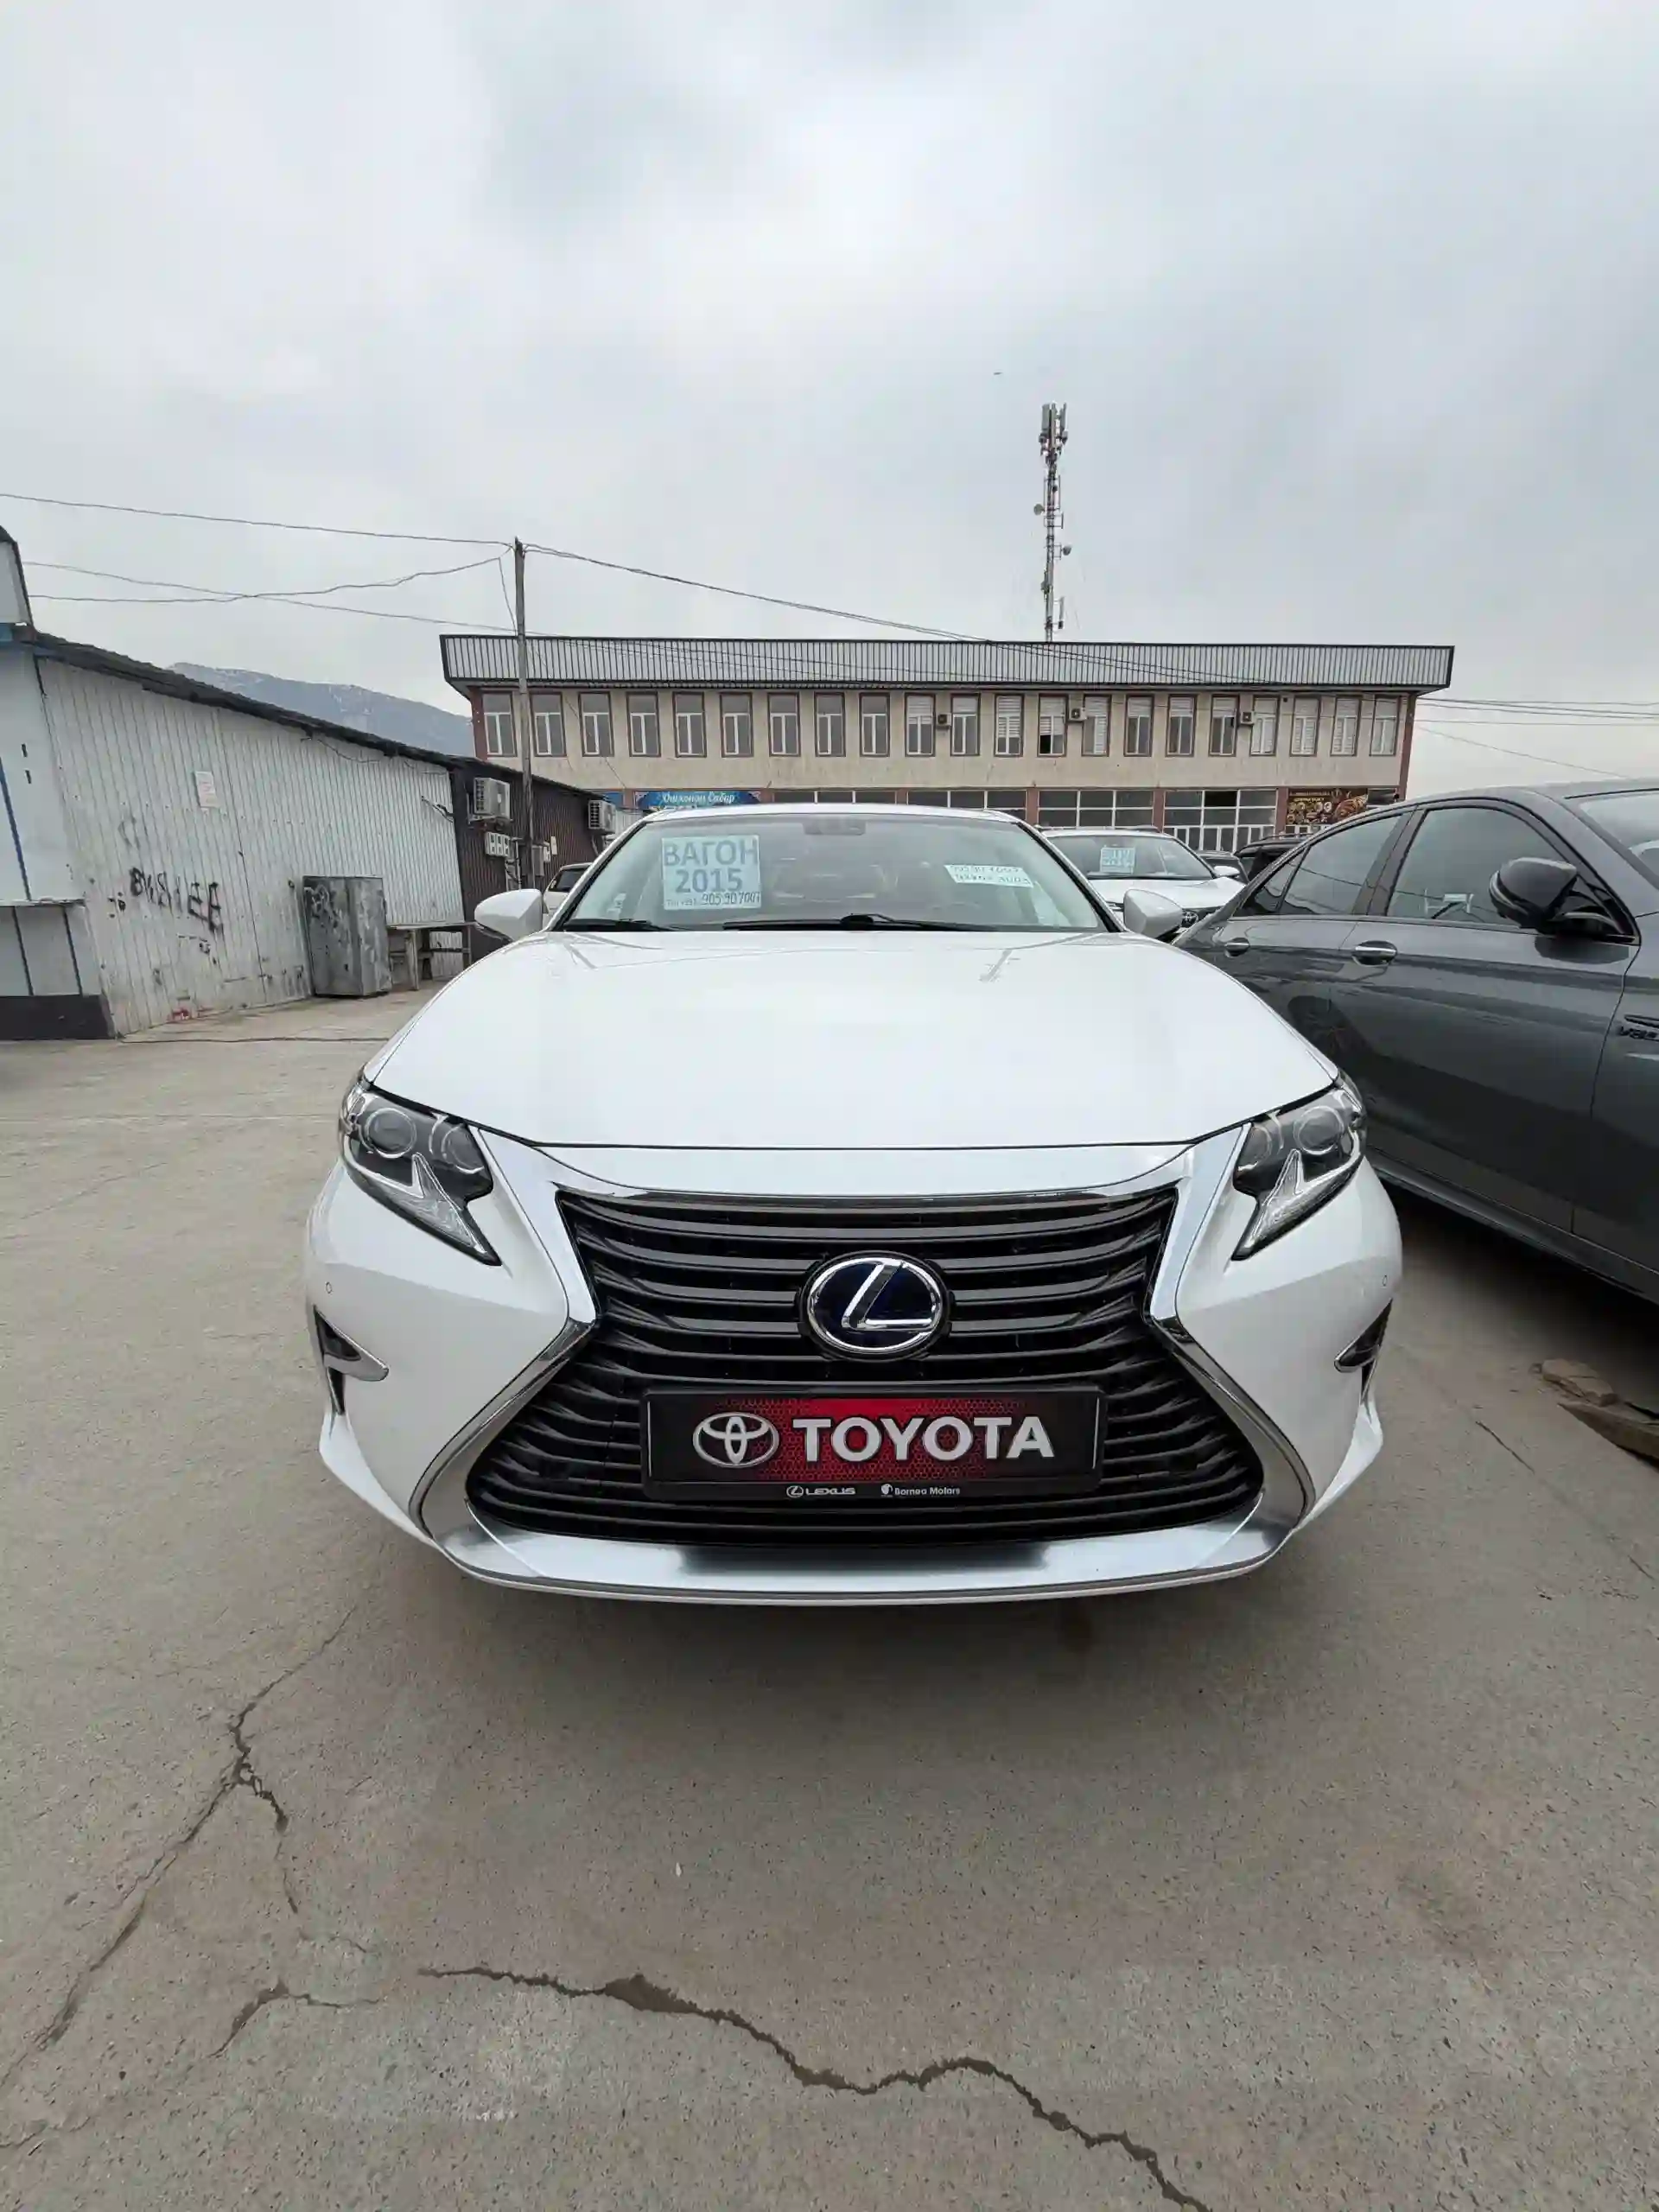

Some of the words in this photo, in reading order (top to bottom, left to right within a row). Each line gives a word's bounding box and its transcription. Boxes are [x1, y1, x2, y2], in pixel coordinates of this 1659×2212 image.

[664, 838, 758, 866] ВАГОН
[675, 868, 743, 893] 2015
[792, 1415, 1054, 1464] TOYOTA
[805, 1486, 856, 1496] LEXUS
